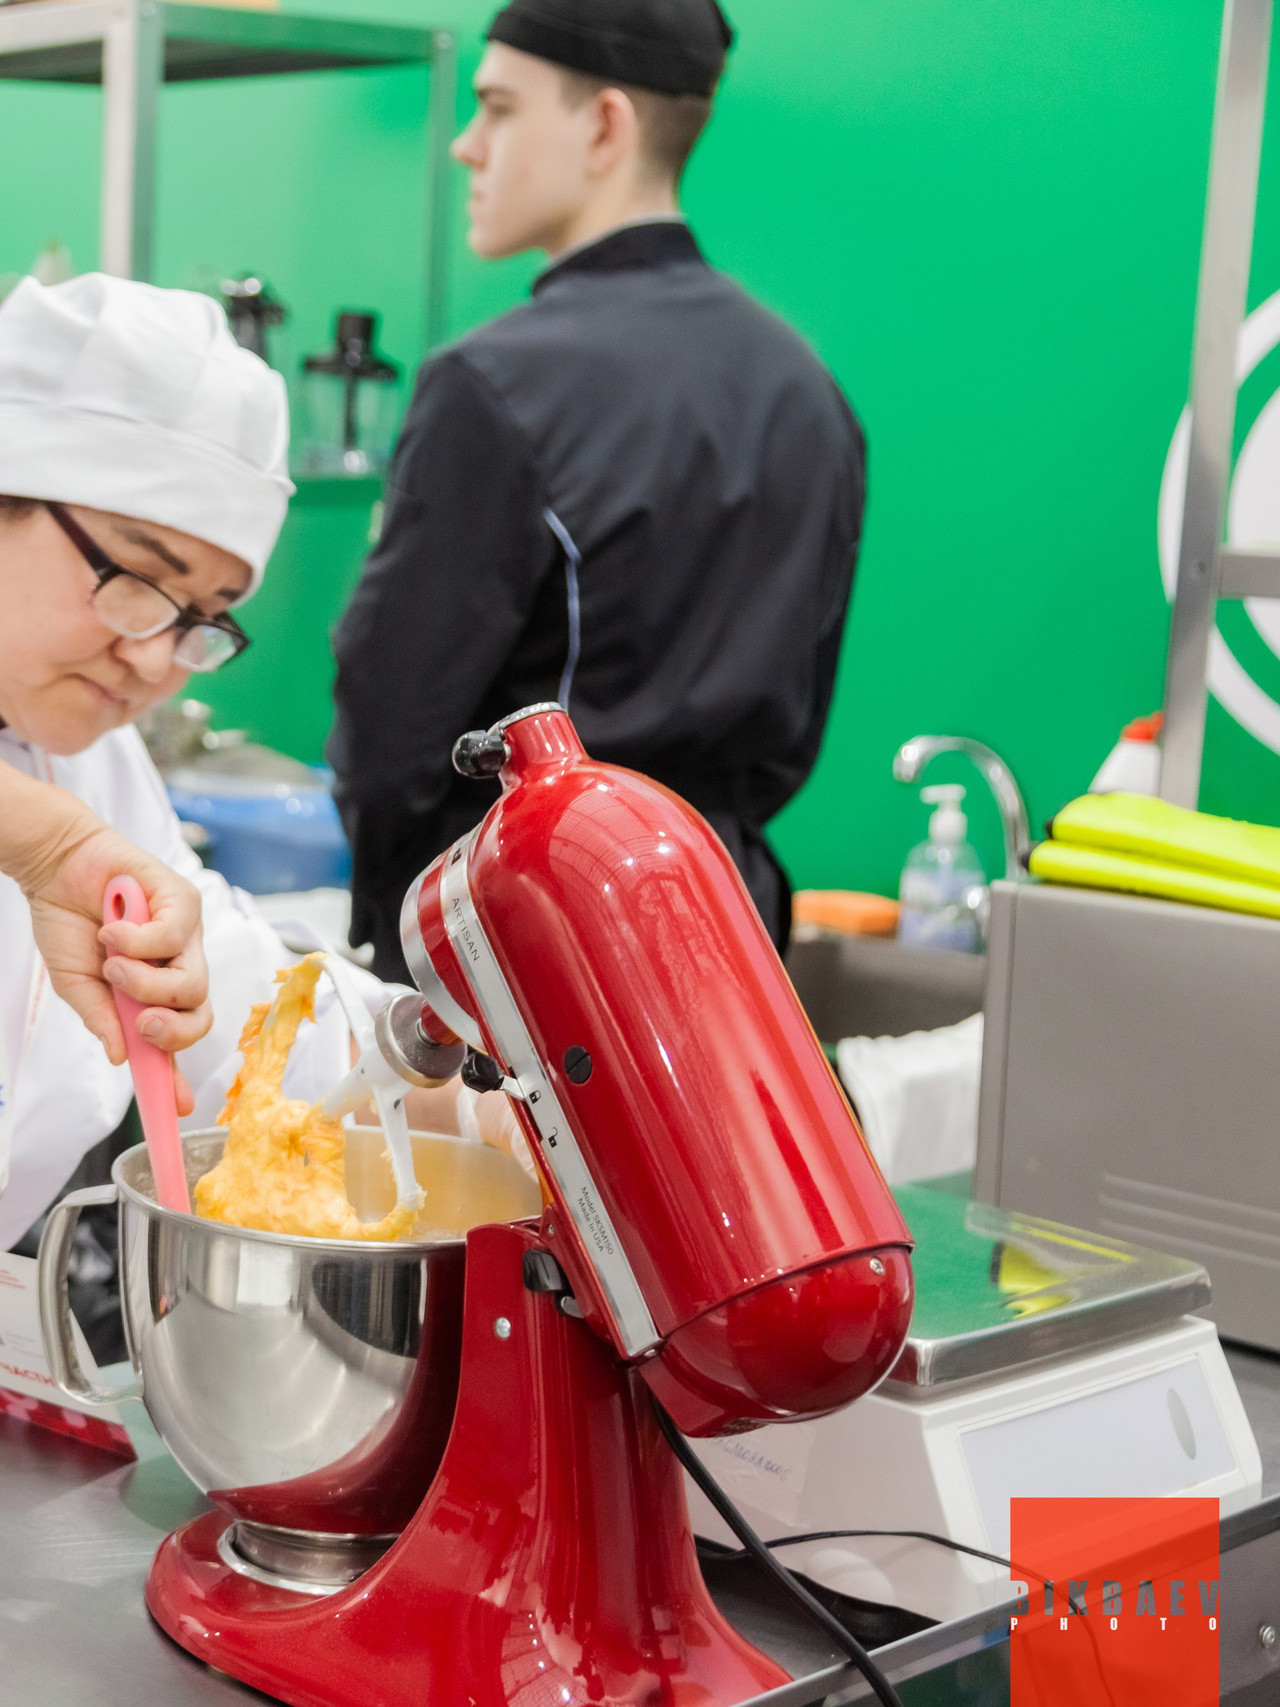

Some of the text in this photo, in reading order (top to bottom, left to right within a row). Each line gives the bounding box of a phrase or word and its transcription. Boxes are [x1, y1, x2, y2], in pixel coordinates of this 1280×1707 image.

[452, 897, 480, 961] ARTISAN
[578, 1198, 591, 1222] Made
[593, 1232, 604, 1253] USA
[581, 1187, 596, 1214] Model
